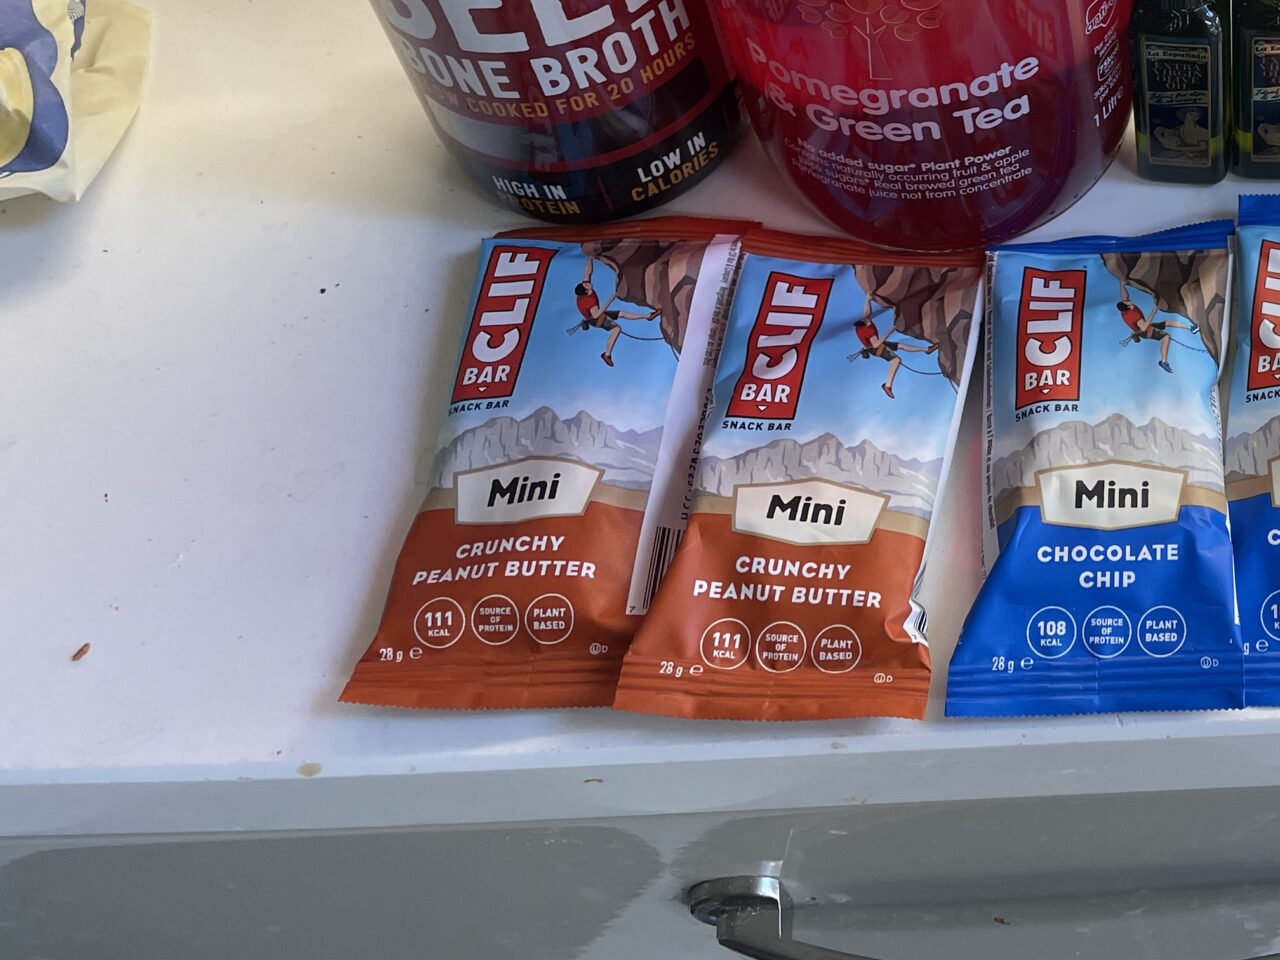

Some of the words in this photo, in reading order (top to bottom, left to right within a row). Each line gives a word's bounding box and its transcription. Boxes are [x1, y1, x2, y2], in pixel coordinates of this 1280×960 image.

[398, 36, 520, 99] BONE
[465, 97, 548, 119] COOKED
[557, 92, 600, 115] FOR
[606, 77, 635, 101] 20
[640, 32, 696, 86] HOURS
[746, 37, 1040, 115] Pomegranate
[806, 105, 941, 141] Green
[952, 94, 1030, 136] Tea
[637, 148, 681, 183] LOW
[687, 132, 706, 157] IN
[818, 148, 863, 168] added
[921, 159, 960, 172] Plant
[964, 145, 1012, 166] Power
[831, 161, 884, 182] naturally
[888, 170, 949, 183] occurring
[952, 164, 977, 178] fruit
[981, 161, 991, 170] &
[995, 148, 1030, 168] apple
[631, 142, 719, 202] CALORIES
[874, 179, 901, 190] Real
[905, 179, 956, 191] brewed
[959, 173, 997, 188] green
[1000, 163, 1020, 175] tea
[492, 176, 539, 200] HIGH
[543, 184, 567, 200] IN
[901, 191, 922, 200] not
[925, 189, 956, 200] from
[960, 166, 1033, 195] concentrate
[471, 251, 541, 363] CLIF
[751, 281, 818, 380] CLIF
[1024, 277, 1076, 367] CLIF
[462, 365, 511, 385] BAR
[1025, 369, 1070, 391] BAR
[740, 383, 791, 404] BAR
[1245, 389, 1280, 404] SNACK
[448, 402, 482, 416] SNACK
[485, 400, 509, 410] BAR
[1015, 403, 1050, 423] SNACK
[1054, 403, 1079, 413] BAR
[722, 420, 763, 431] SNACK
[768, 421, 792, 432] BAR
[487, 473, 561, 507] Mini
[1074, 480, 1149, 509] Mini
[765, 494, 846, 526] Mini
[455, 535, 565, 559] CRUNCHY
[1036, 544, 1179, 563] CHOCOLATE
[411, 562, 499, 586] PEANUT
[504, 560, 596, 579] BUTTER
[735, 555, 851, 581] CRUNCHY
[1078, 570, 1136, 589] CHIP
[693, 579, 785, 603] PEANUT
[791, 585, 882, 609] BUTTER
[424, 611, 453, 627] 111
[479, 607, 511, 616] SOURCE
[490, 616, 501, 624] OF
[533, 608, 566, 618] PLANT
[479, 624, 513, 633] PROTEIN
[533, 620, 565, 631] BASED
[1037, 620, 1066, 636] 108
[1091, 617, 1124, 627] SOURCE
[1101, 627, 1112, 635] OF
[1146, 619, 1178, 630] PLANT
[427, 629, 450, 637] KCAL
[712, 631, 741, 649] 111
[765, 633, 799, 643] SOURCE
[1040, 638, 1062, 647] KCAL
[1089, 636, 1125, 645] PROTEIN
[1145, 632, 1178, 642] BASED
[775, 643, 787, 652] OF
[820, 638, 853, 649] PLANT
[713, 650, 735, 660] KCAL
[762, 651, 799, 661] PROTEIN
[819, 651, 853, 661] BASED
